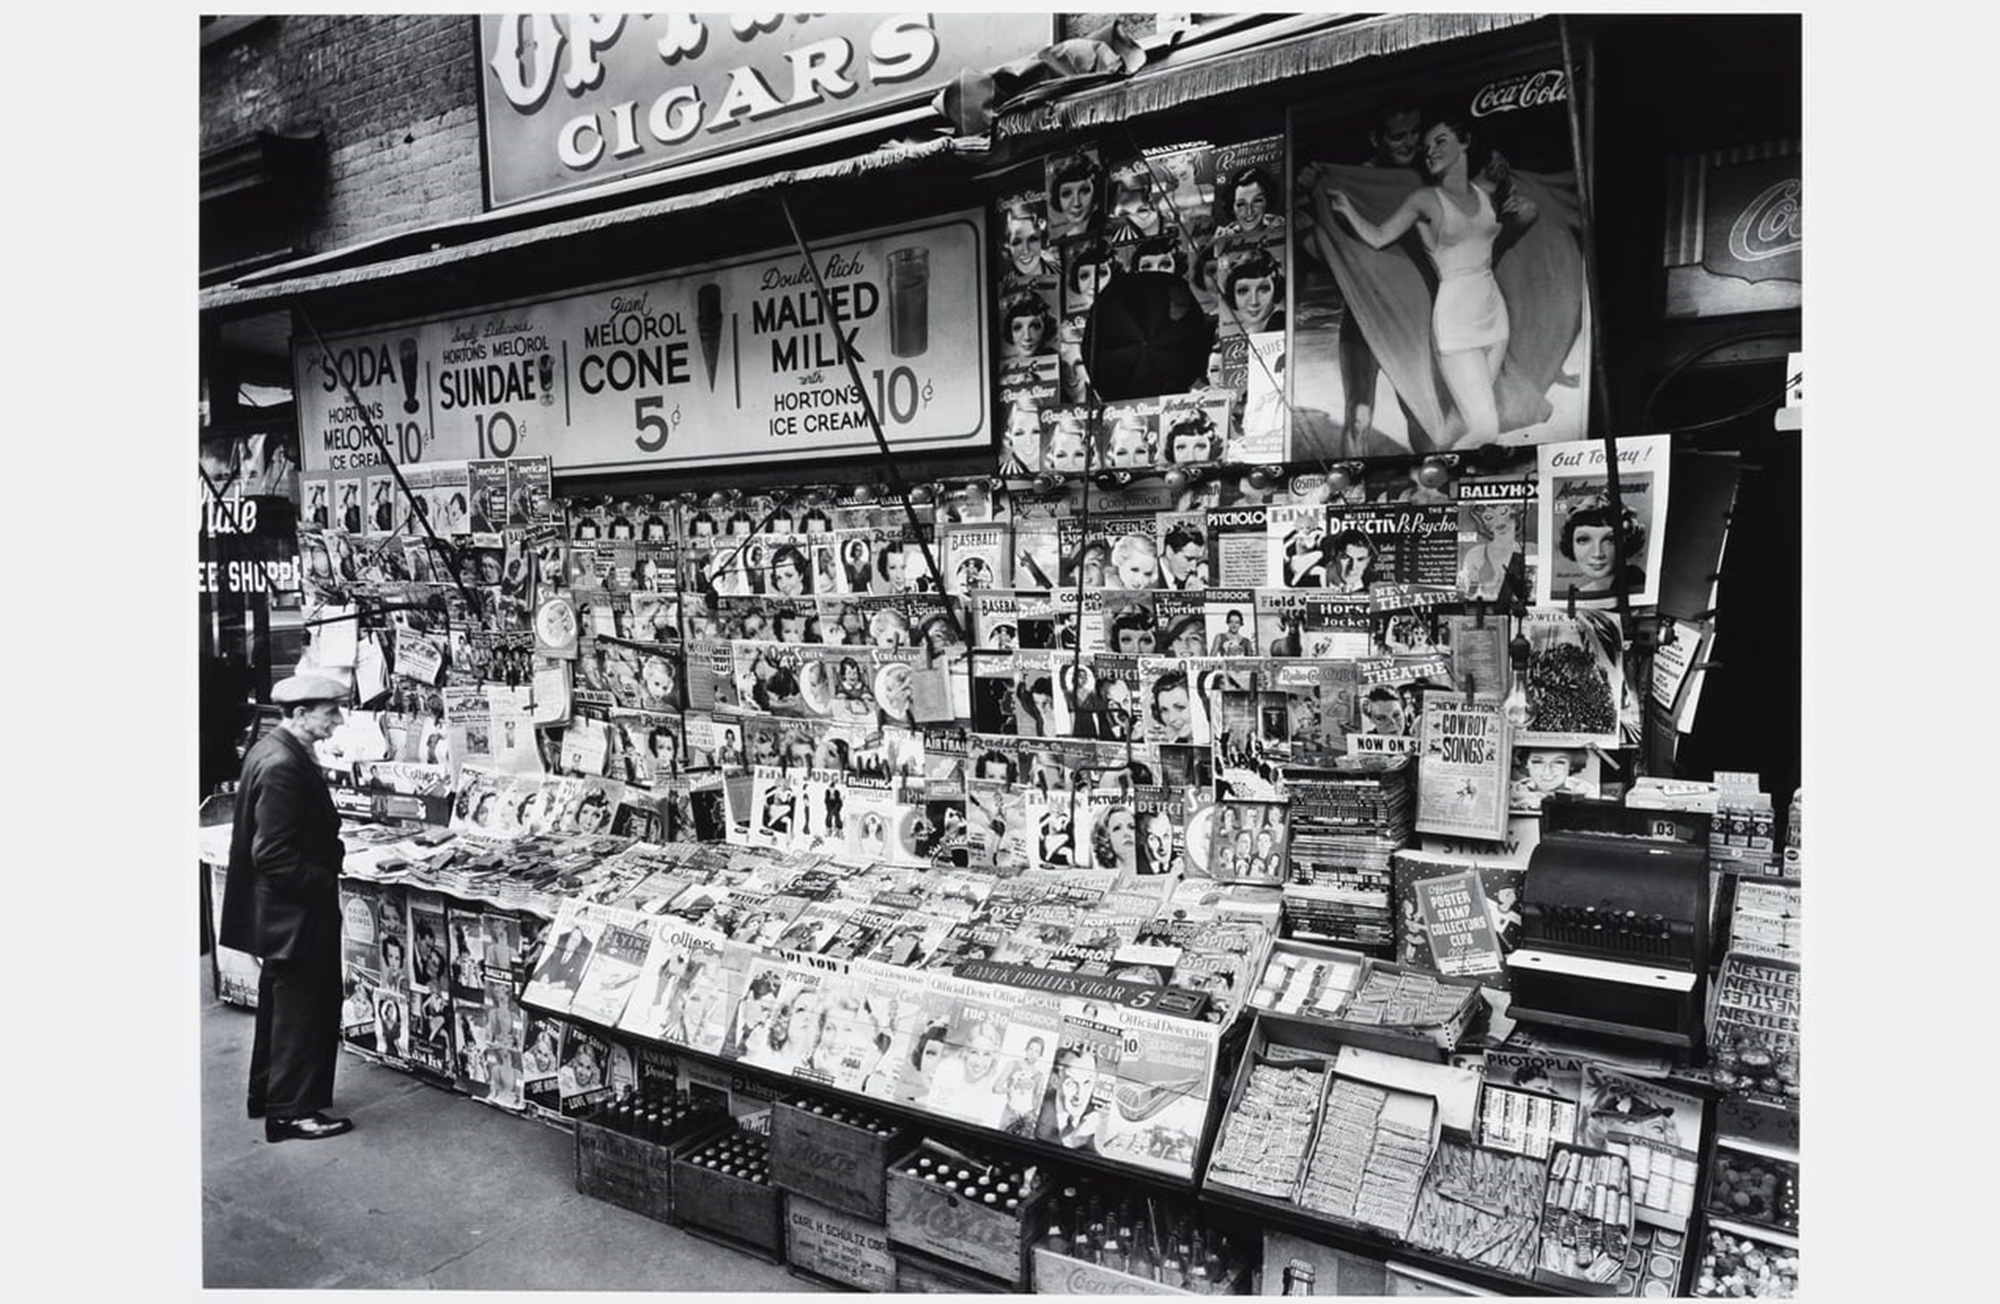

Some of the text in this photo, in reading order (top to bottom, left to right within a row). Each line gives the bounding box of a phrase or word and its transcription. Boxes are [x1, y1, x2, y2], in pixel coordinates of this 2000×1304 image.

[556, 13, 940, 170] CIGARS
[824, 250, 864, 279] Rich
[760, 266, 811, 293] Doubl
[753, 282, 879, 335] MALTED
[584, 312, 687, 350] MELOROL
[493, 336, 549, 357] MELOROL
[772, 327, 866, 374] MILK
[323, 343, 396, 394] SODA
[579, 342, 691, 395] CONE
[440, 357, 536, 411] SUNDAE
[774, 384, 862, 412] HORTON'S
[770, 415, 798, 437] ICE
[329, 455, 347, 472] ICE
[1551, 450, 1582, 468] Out
[1588, 447, 1639, 470] Toay
[1363, 662, 1447, 684] THEATRE
[1441, 715, 1488, 737] COWBOY
[1357, 737, 1406, 752] NOW ON
[1441, 737, 1485, 764] SONGS
[1430, 891, 1471, 908] POSTER
[1430, 916, 1487, 936] COLLECTORS
[1437, 906, 1471, 922] STAMP
[659, 921, 716, 951] Collier's
[1013, 969, 1077, 993] PHILLIES
[1079, 978, 1126, 1000] CIGAR
[1118, 1011, 1213, 1039] Official Detective
[1123, 1038, 1138, 1053] 10
[1487, 1052, 1584, 1072] PHOTOPLAY
[817, 1222, 824, 1232] H
